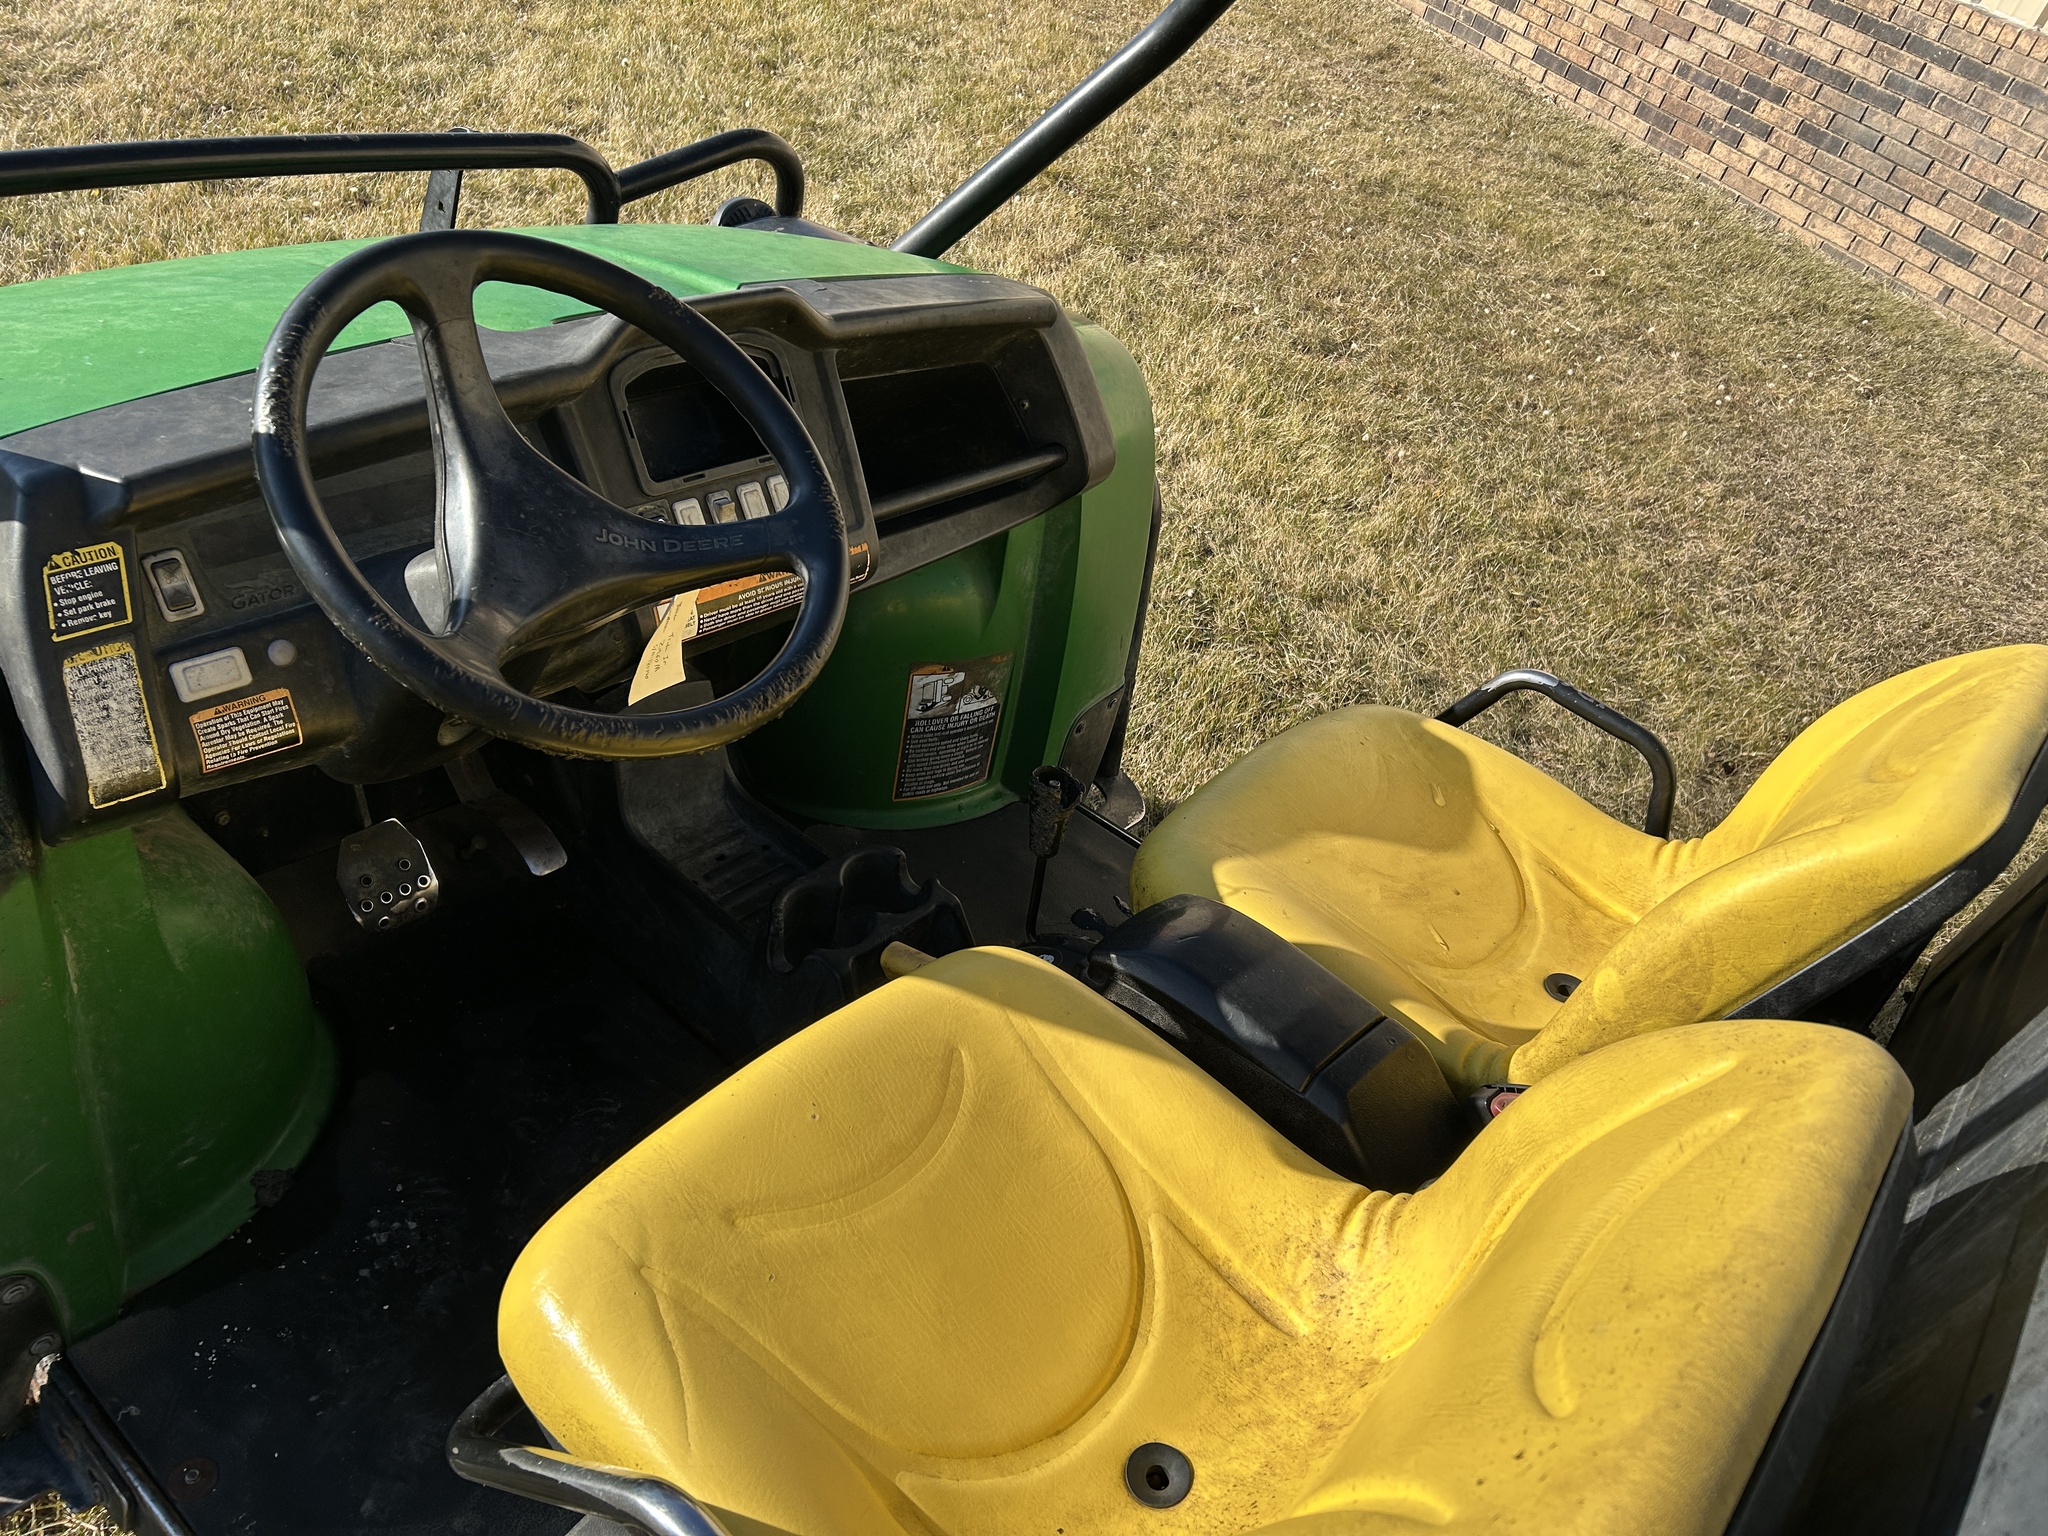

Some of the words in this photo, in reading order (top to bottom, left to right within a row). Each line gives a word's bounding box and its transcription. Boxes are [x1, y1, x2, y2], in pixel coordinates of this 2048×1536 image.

[596, 528, 656, 552] JOHN
[663, 534, 744, 553] DEERE
[62, 544, 117, 569] CAUTION
[50, 569, 84, 586] BEFORE
[83, 560, 119, 578] LEAVING
[59, 595, 77, 608] Stop
[78, 589, 104, 603] engine
[63, 607, 77, 617] Set
[78, 603, 94, 614] park
[95, 597, 116, 609] brake
[231, 584, 295, 610] GATOR
[739, 589, 756, 601] AVOID
[67, 613, 97, 627] Remove
[98, 609, 112, 620] key
[195, 716, 223, 730] Operation
[230, 711, 242, 719] This
[242, 702, 272, 716] Equipment
[272, 698, 284, 707] May
[222, 694, 266, 712] WARNING
[197, 725, 216, 735] Create
[216, 719, 236, 730] Sparks
[237, 715, 249, 724] That
[249, 712, 261, 720] Can
[261, 708, 274, 716] Start
[275, 704, 289, 712] Fires
[199, 731, 220, 741] Around
[220, 727, 231, 736] Dry
[268, 711, 285, 722] Spark
[915, 717, 949, 726] ROLLOVER
[950, 715, 959, 723] OR
[960, 709, 983, 720] FALLING
[984, 706, 995, 714] OFF
[925, 724, 946, 732] CAUSE
[947, 720, 968, 729] INJURY
[203, 742, 228, 754] Operator
[228, 736, 248, 746] Should
[248, 730, 269, 740] Contact
[269, 725, 284, 734] Local
[285, 721, 296, 729] Fire
[225, 732, 238, 742] May
[273, 718, 284, 726] The
[204, 748, 231, 760] Agencies
[241, 740, 256, 749] Laws
[263, 728, 295, 742] Regulations
[206, 754, 230, 765] Relating
[249, 739, 278, 752] Prevention
